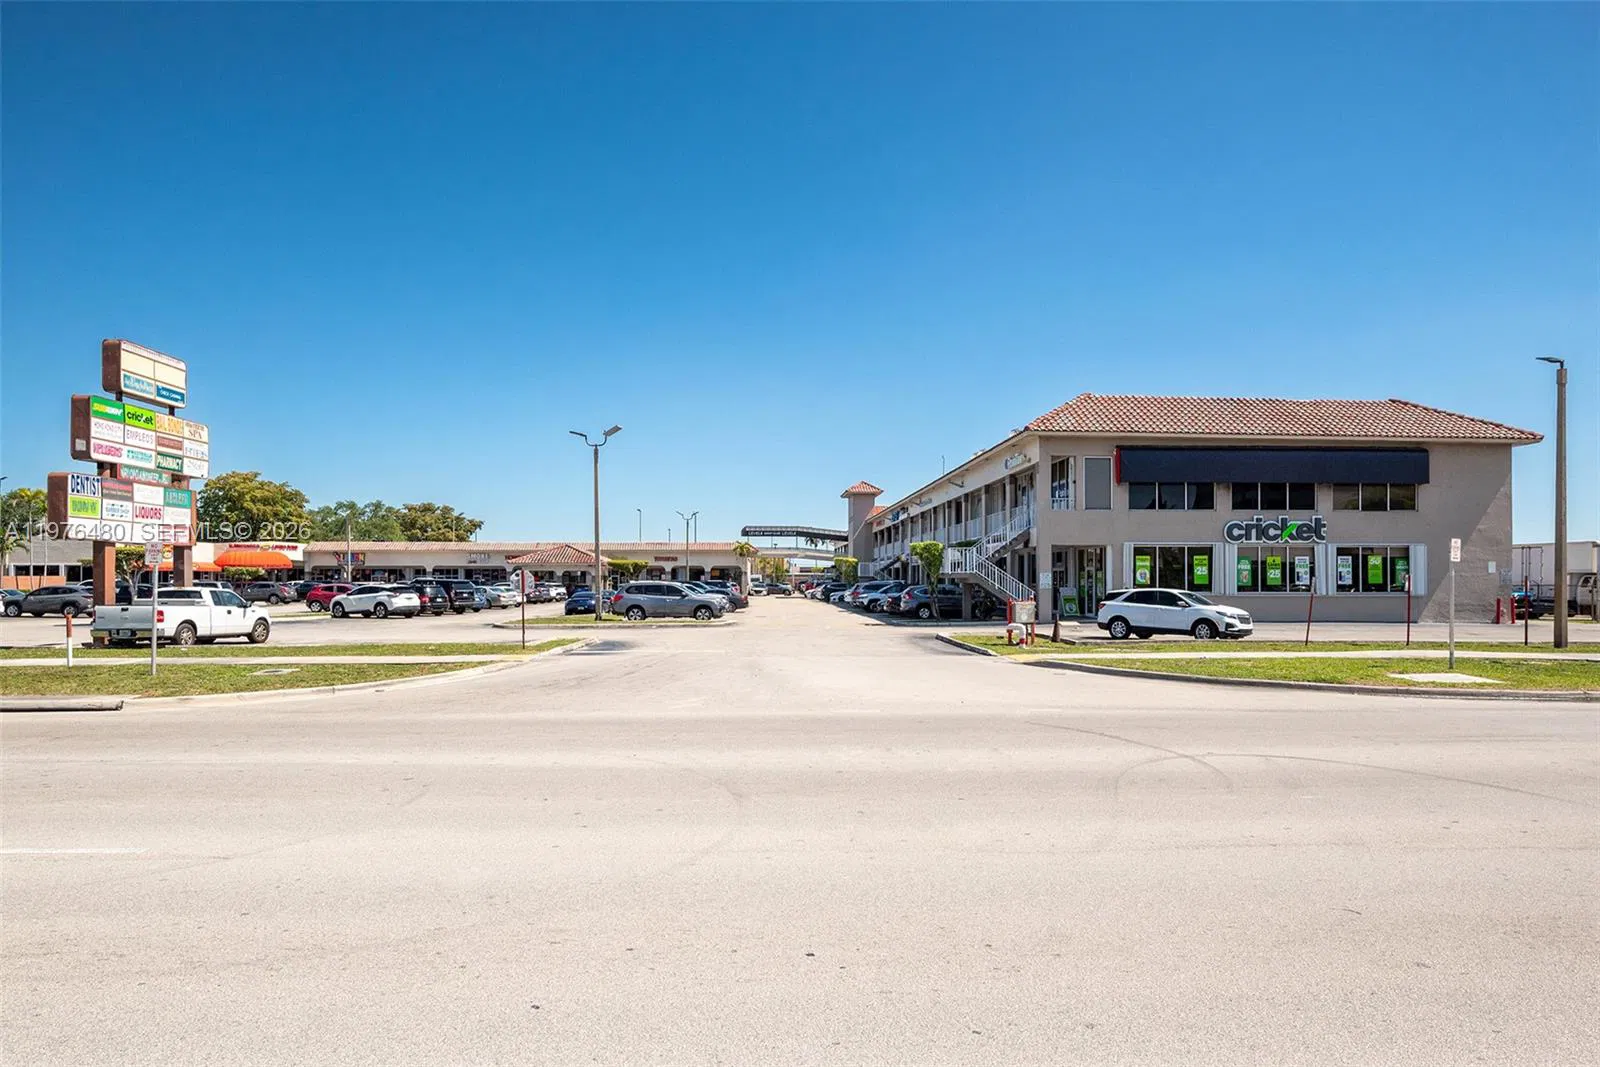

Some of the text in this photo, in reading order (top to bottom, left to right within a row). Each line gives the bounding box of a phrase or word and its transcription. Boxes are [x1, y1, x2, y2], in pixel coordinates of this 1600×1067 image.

[126, 411, 154, 425] cricket
[71, 474, 100, 496] DENTIST
[134, 503, 162, 520] LIQUORS
[1224, 515, 1327, 544] cricket
